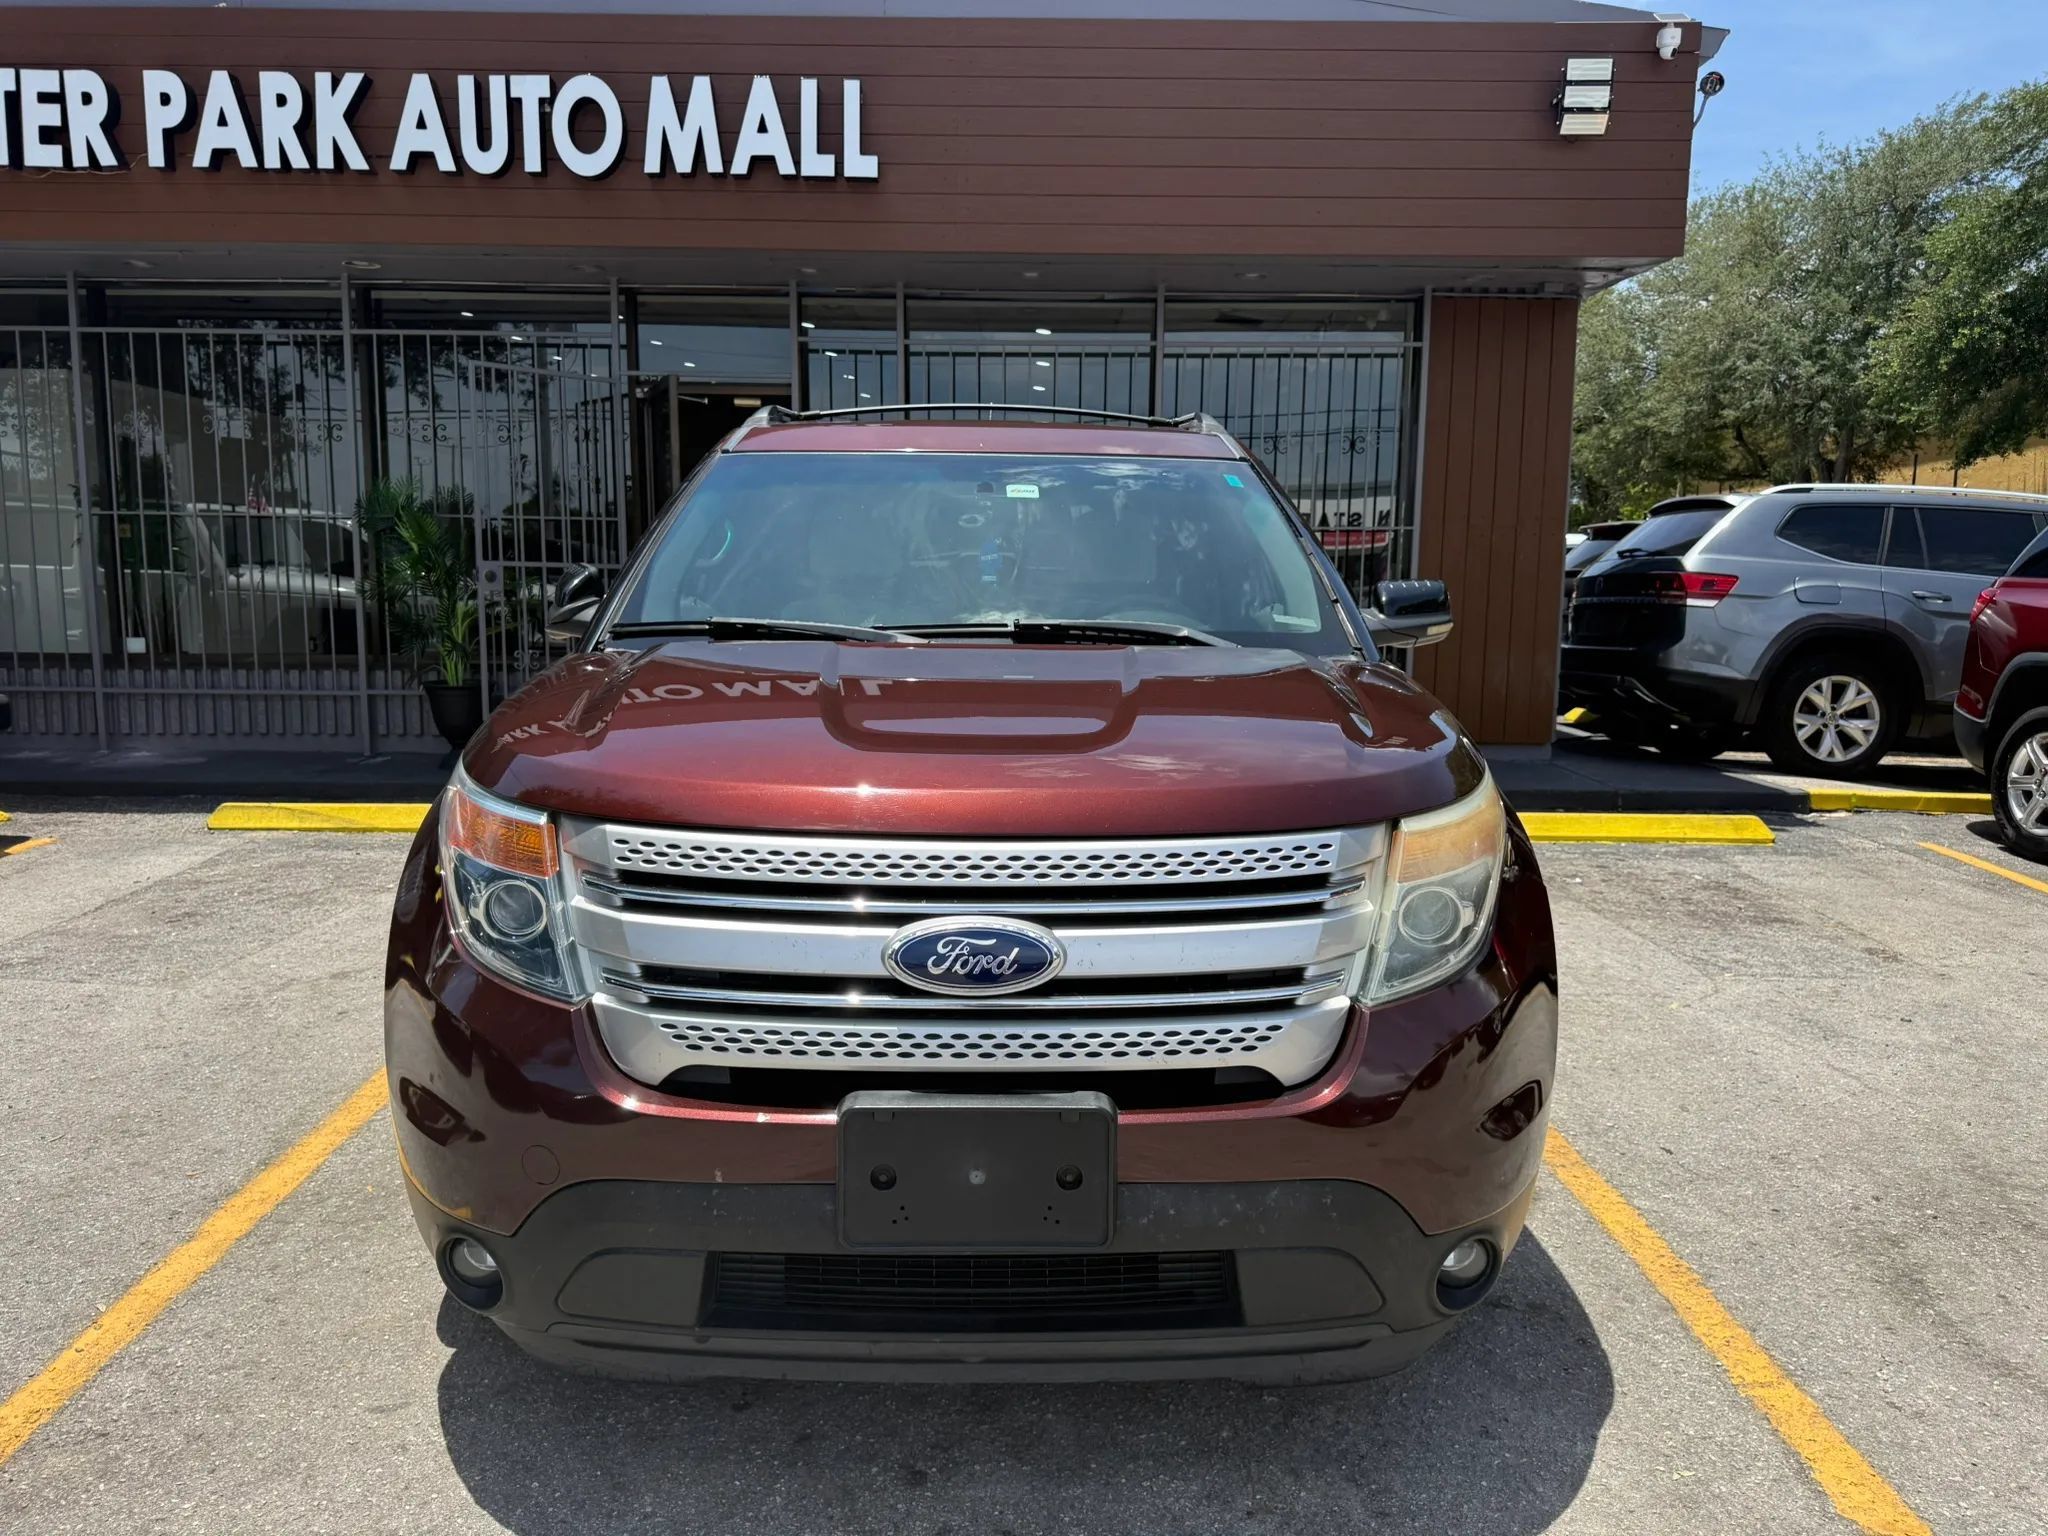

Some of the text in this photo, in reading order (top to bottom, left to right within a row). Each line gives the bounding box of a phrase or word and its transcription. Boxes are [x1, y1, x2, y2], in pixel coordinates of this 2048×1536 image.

[142, 69, 369, 171] PARK
[390, 73, 623, 177] AUTO
[644, 75, 879, 179] MALL
[926, 936, 1020, 975] Ford
